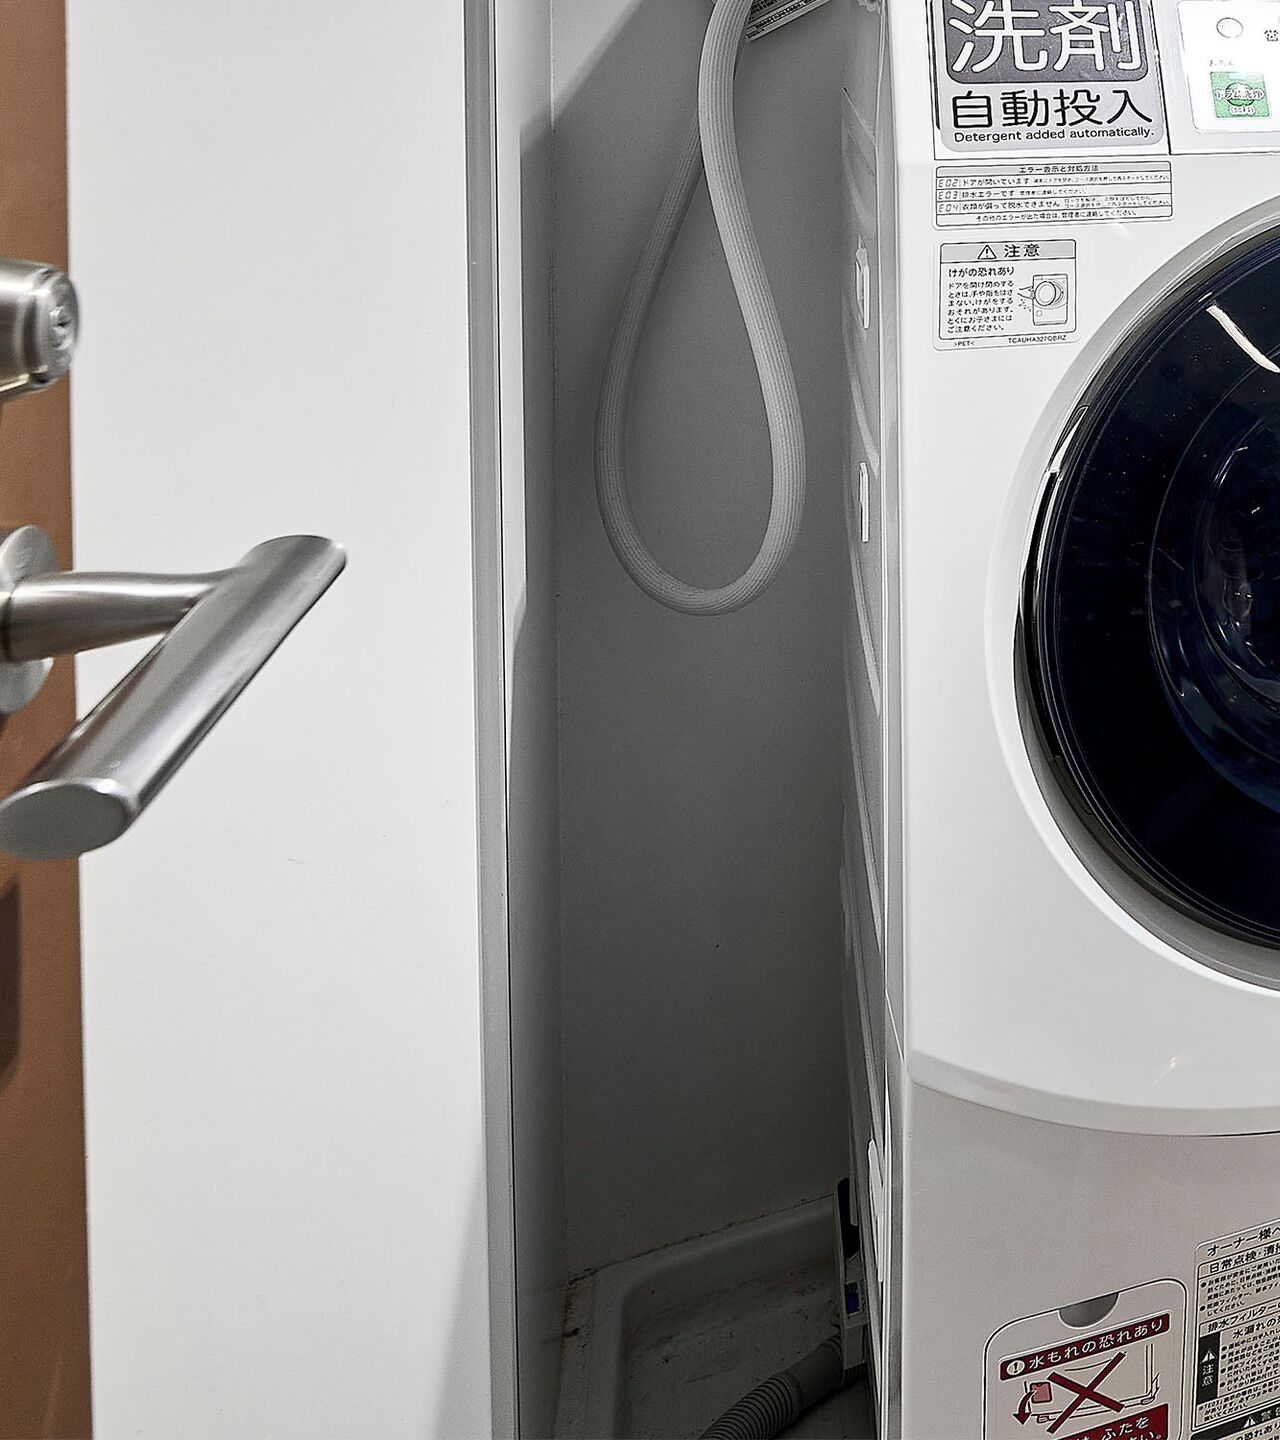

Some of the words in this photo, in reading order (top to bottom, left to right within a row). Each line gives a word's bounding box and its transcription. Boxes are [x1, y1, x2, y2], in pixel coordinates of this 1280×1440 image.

[951, 89, 1152, 129] 自動投入
[954, 130, 1022, 143] Detergent
[1025, 130, 1066, 140] added
[1069, 127, 1155, 139] automatically.
[1019, 165, 1099, 174] エラー表示と対処方法
[962, 177, 1029, 187] ドアが開いています
[1004, 243, 1041, 258] 注意
[948, 267, 1015, 277] けがの恐れあり
[1029, 1318, 1163, 1369] 水もれの恐れあり
[1202, 1364, 1214, 1386] 注意
